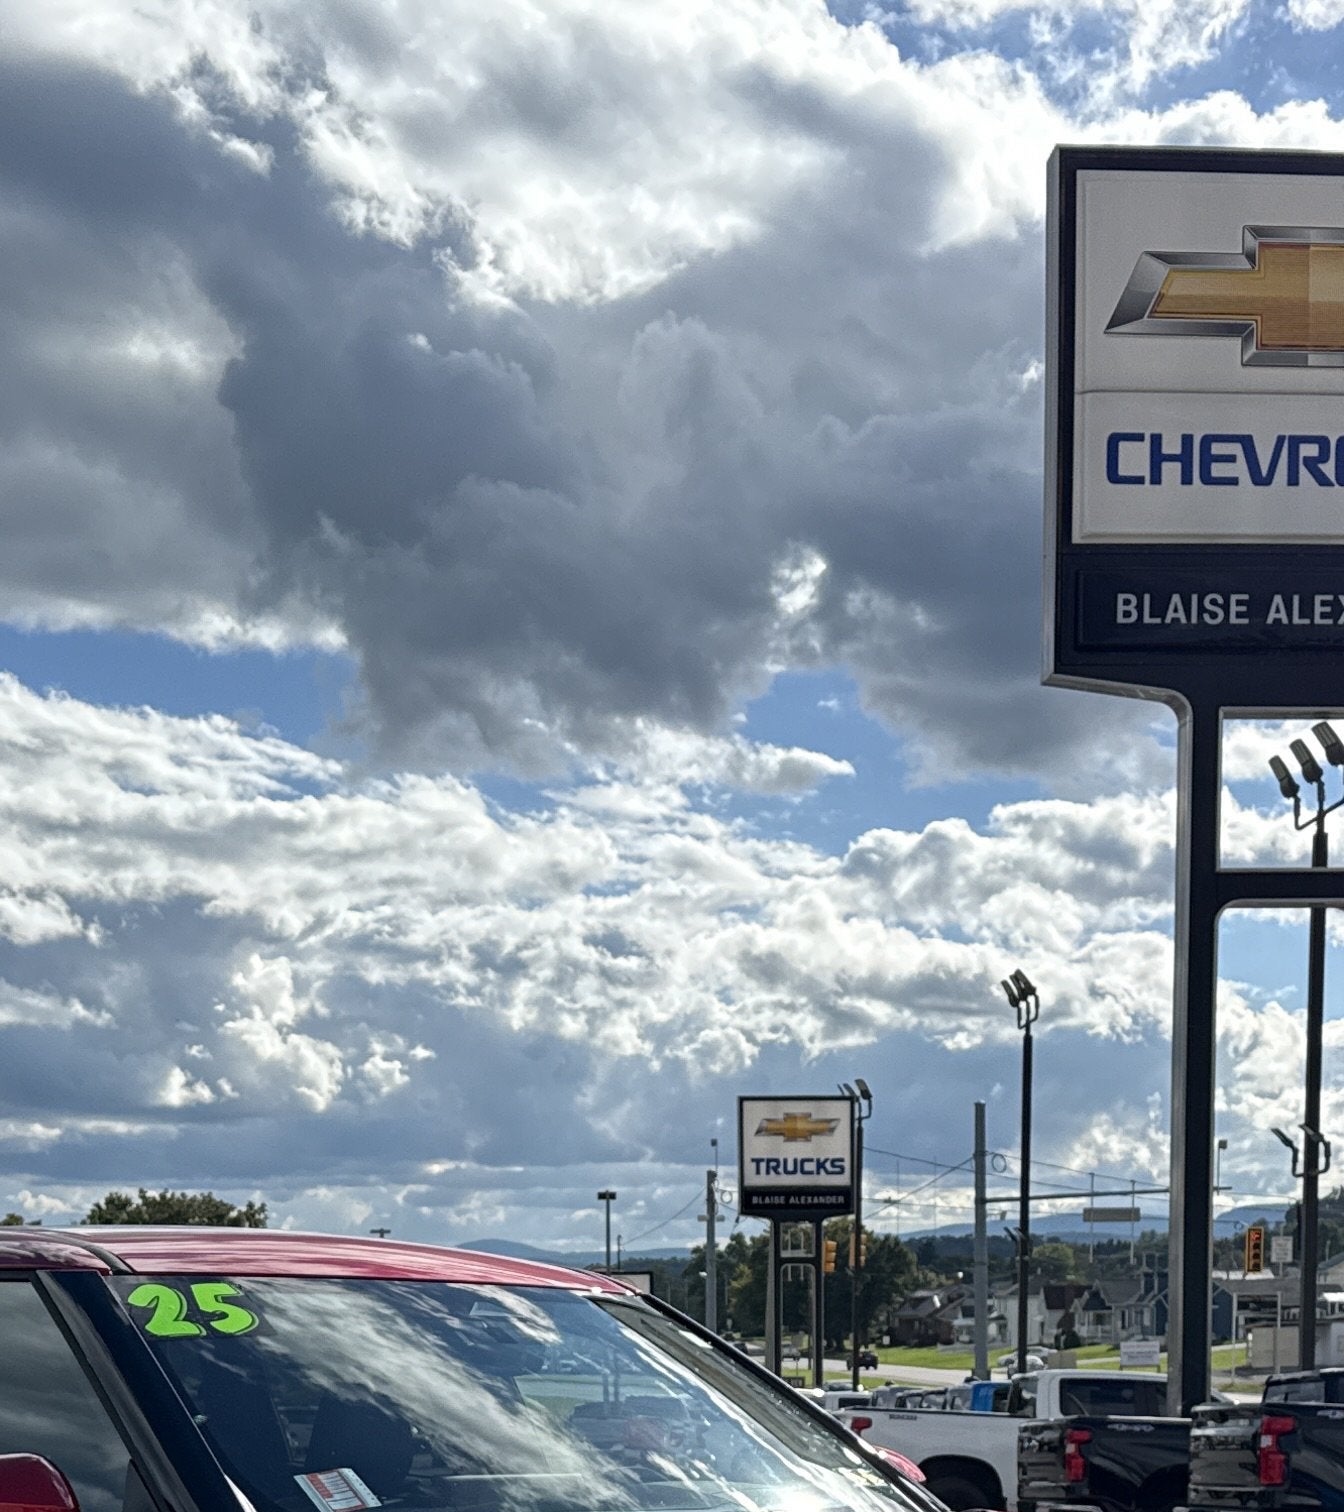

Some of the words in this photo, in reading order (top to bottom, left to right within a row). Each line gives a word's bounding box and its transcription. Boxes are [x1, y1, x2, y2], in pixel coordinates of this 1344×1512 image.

[1115, 592, 1251, 625] BLAISE
[750, 1157, 846, 1176] TRUCKS
[752, 1195, 786, 1205] BLAISE
[788, 1195, 845, 1205] ALEXANDER
[127, 1282, 260, 1337] 25
